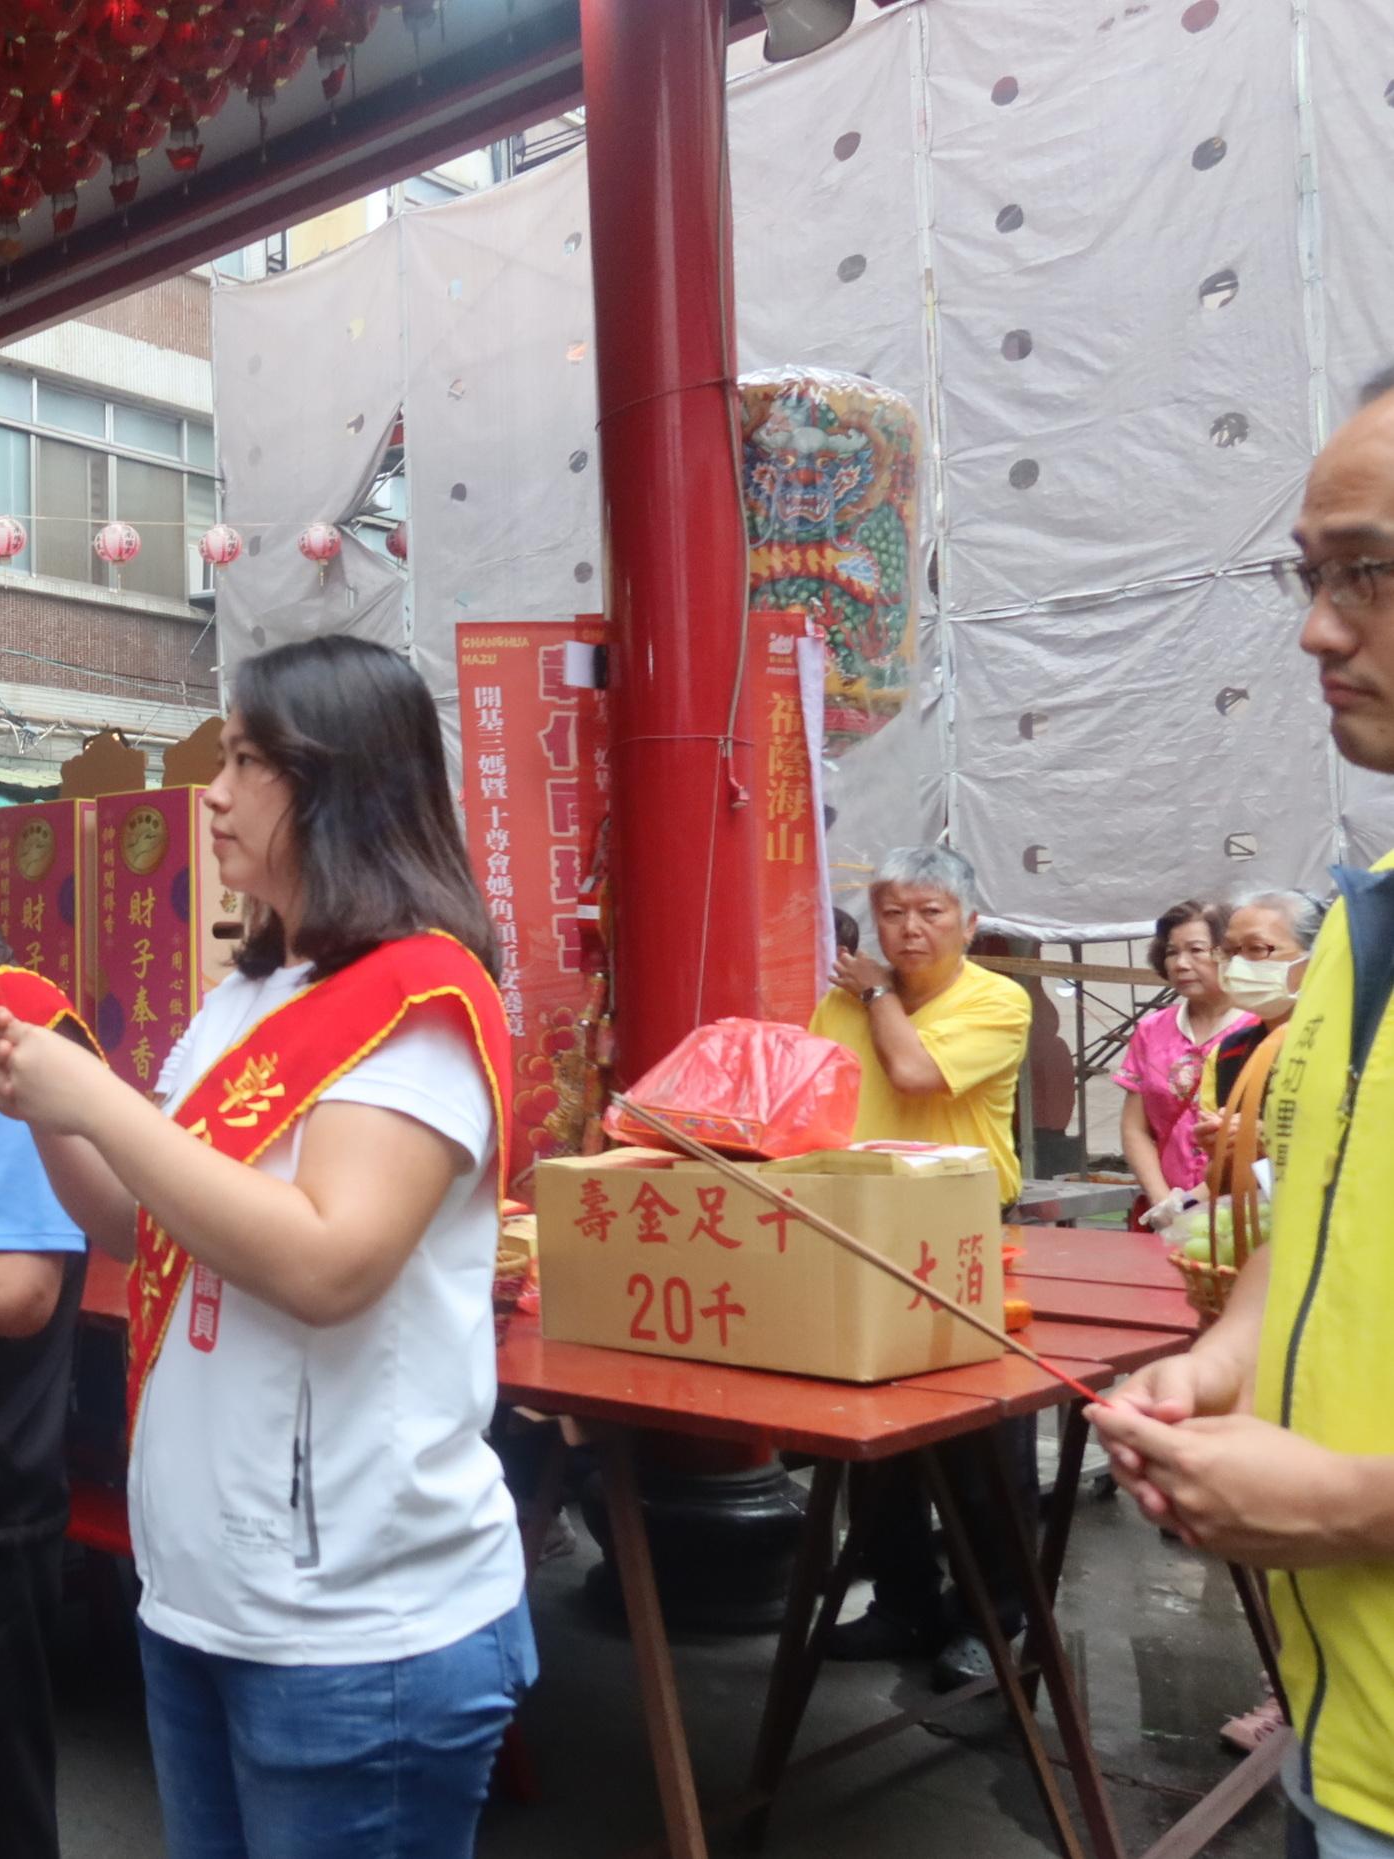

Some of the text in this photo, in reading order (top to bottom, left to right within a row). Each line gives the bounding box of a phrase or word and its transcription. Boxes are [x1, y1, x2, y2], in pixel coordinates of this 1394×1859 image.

[462, 635, 530, 648] CHANGHUA
[766, 690, 808, 866] 福蔭海山
[128, 886, 158, 1080] 財子奉香
[186, 1051, 286, 1146] 彰
[626, 1273, 746, 1347] 20千
